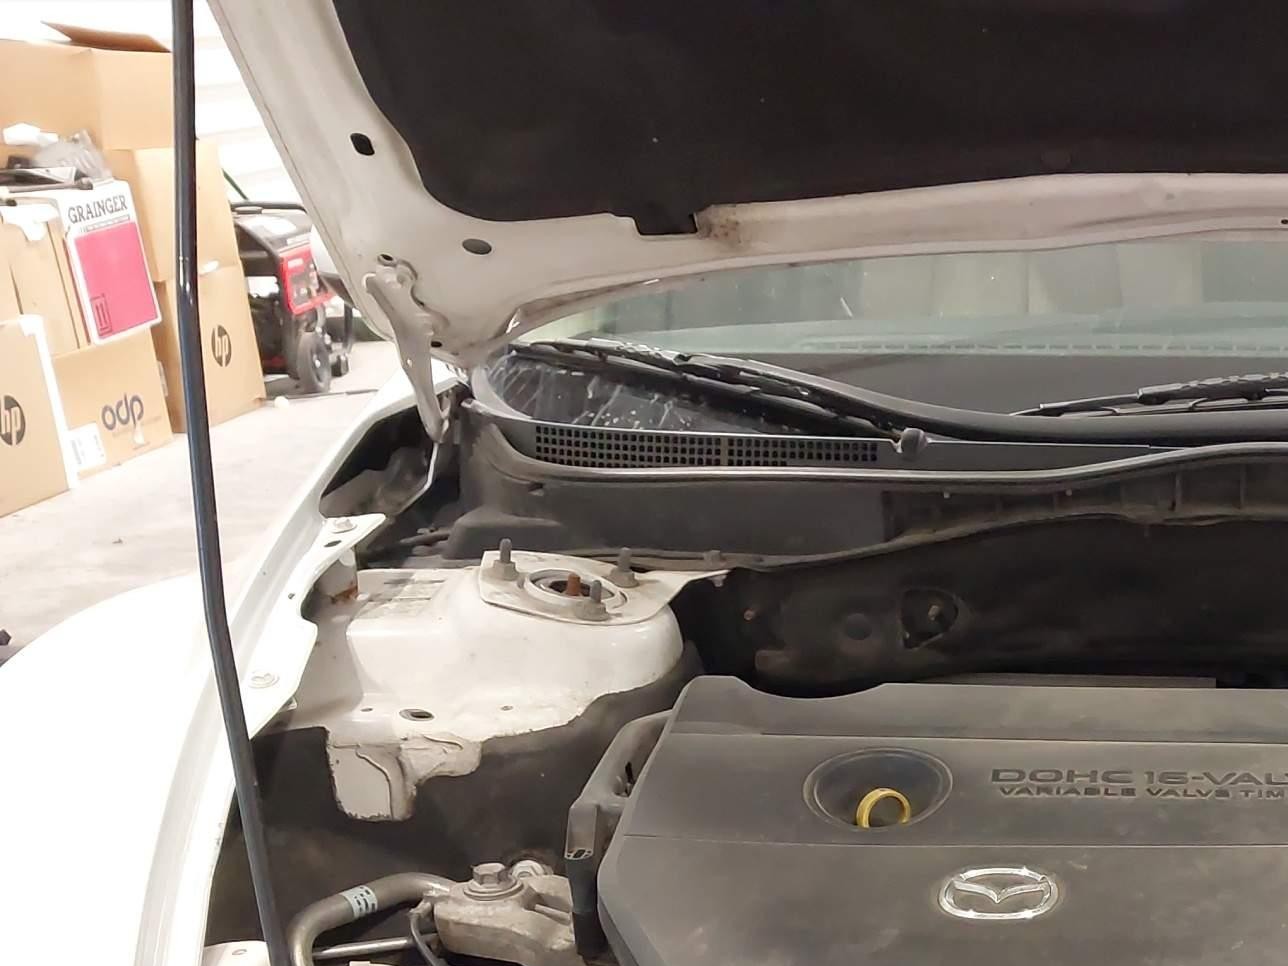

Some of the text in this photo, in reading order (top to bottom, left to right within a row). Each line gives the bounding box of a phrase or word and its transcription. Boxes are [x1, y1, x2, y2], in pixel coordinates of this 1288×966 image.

[68, 195, 128, 224] GRAINGER
[212, 325, 232, 367] hp
[991, 768, 1134, 785] DOHC
[1000, 786, 1137, 798] VARIABLE
[1146, 787, 1231, 798] VALVE
